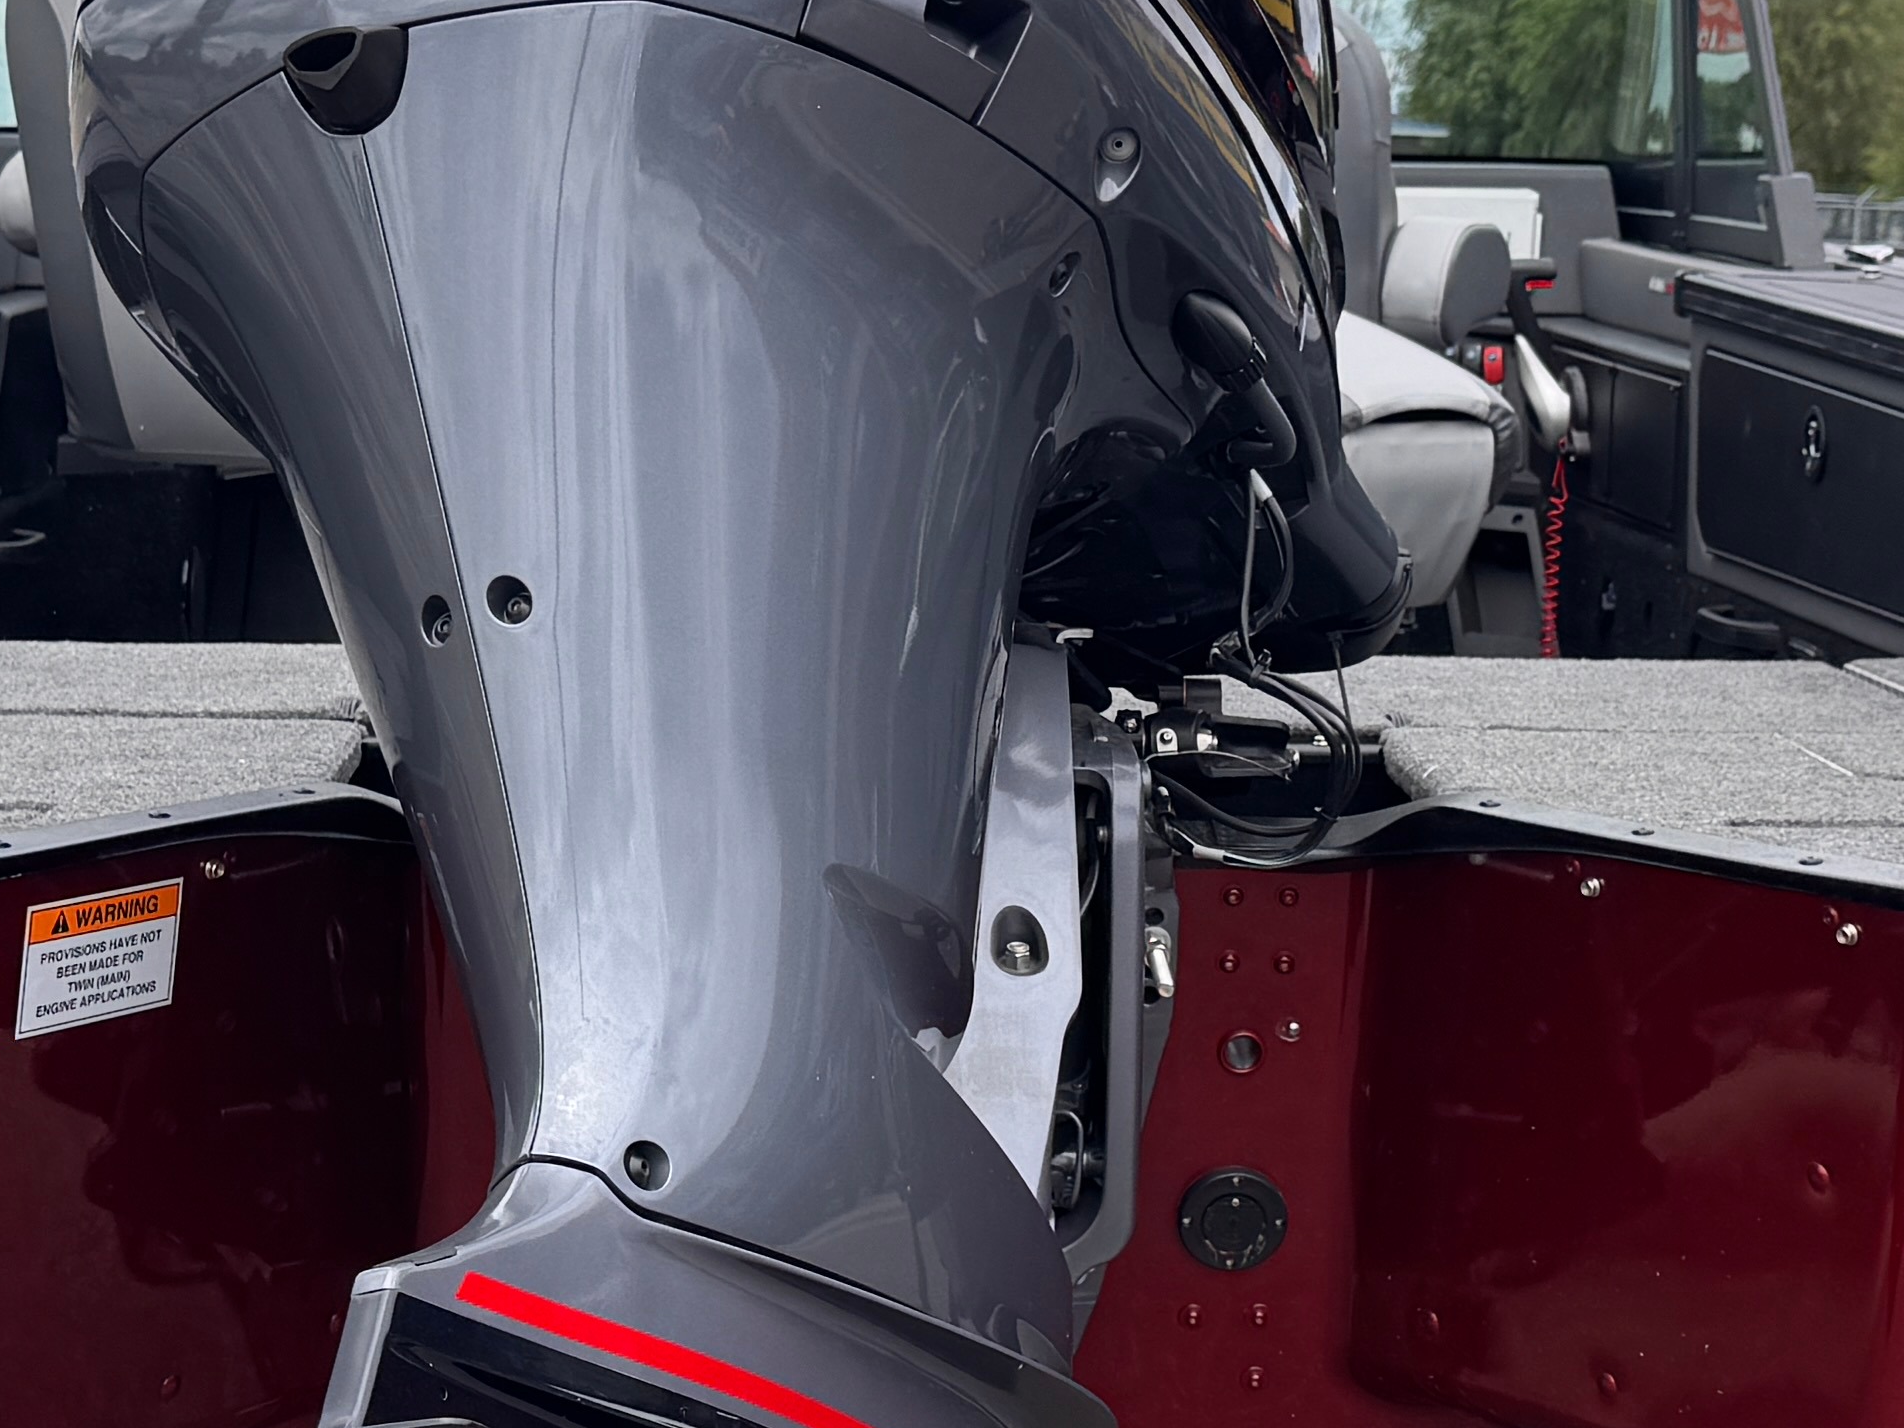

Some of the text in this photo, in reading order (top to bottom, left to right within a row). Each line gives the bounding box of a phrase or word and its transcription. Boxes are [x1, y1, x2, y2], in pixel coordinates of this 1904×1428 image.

[75, 894, 159, 929] WARNING
[40, 929, 162, 965] PROVISIONS HAVE NOT
[56, 950, 144, 979] BEEN MADE FOR
[35, 980, 157, 1018] ENGINE APPLICATIONS
[67, 970, 131, 993] TWIN (MAIN)
